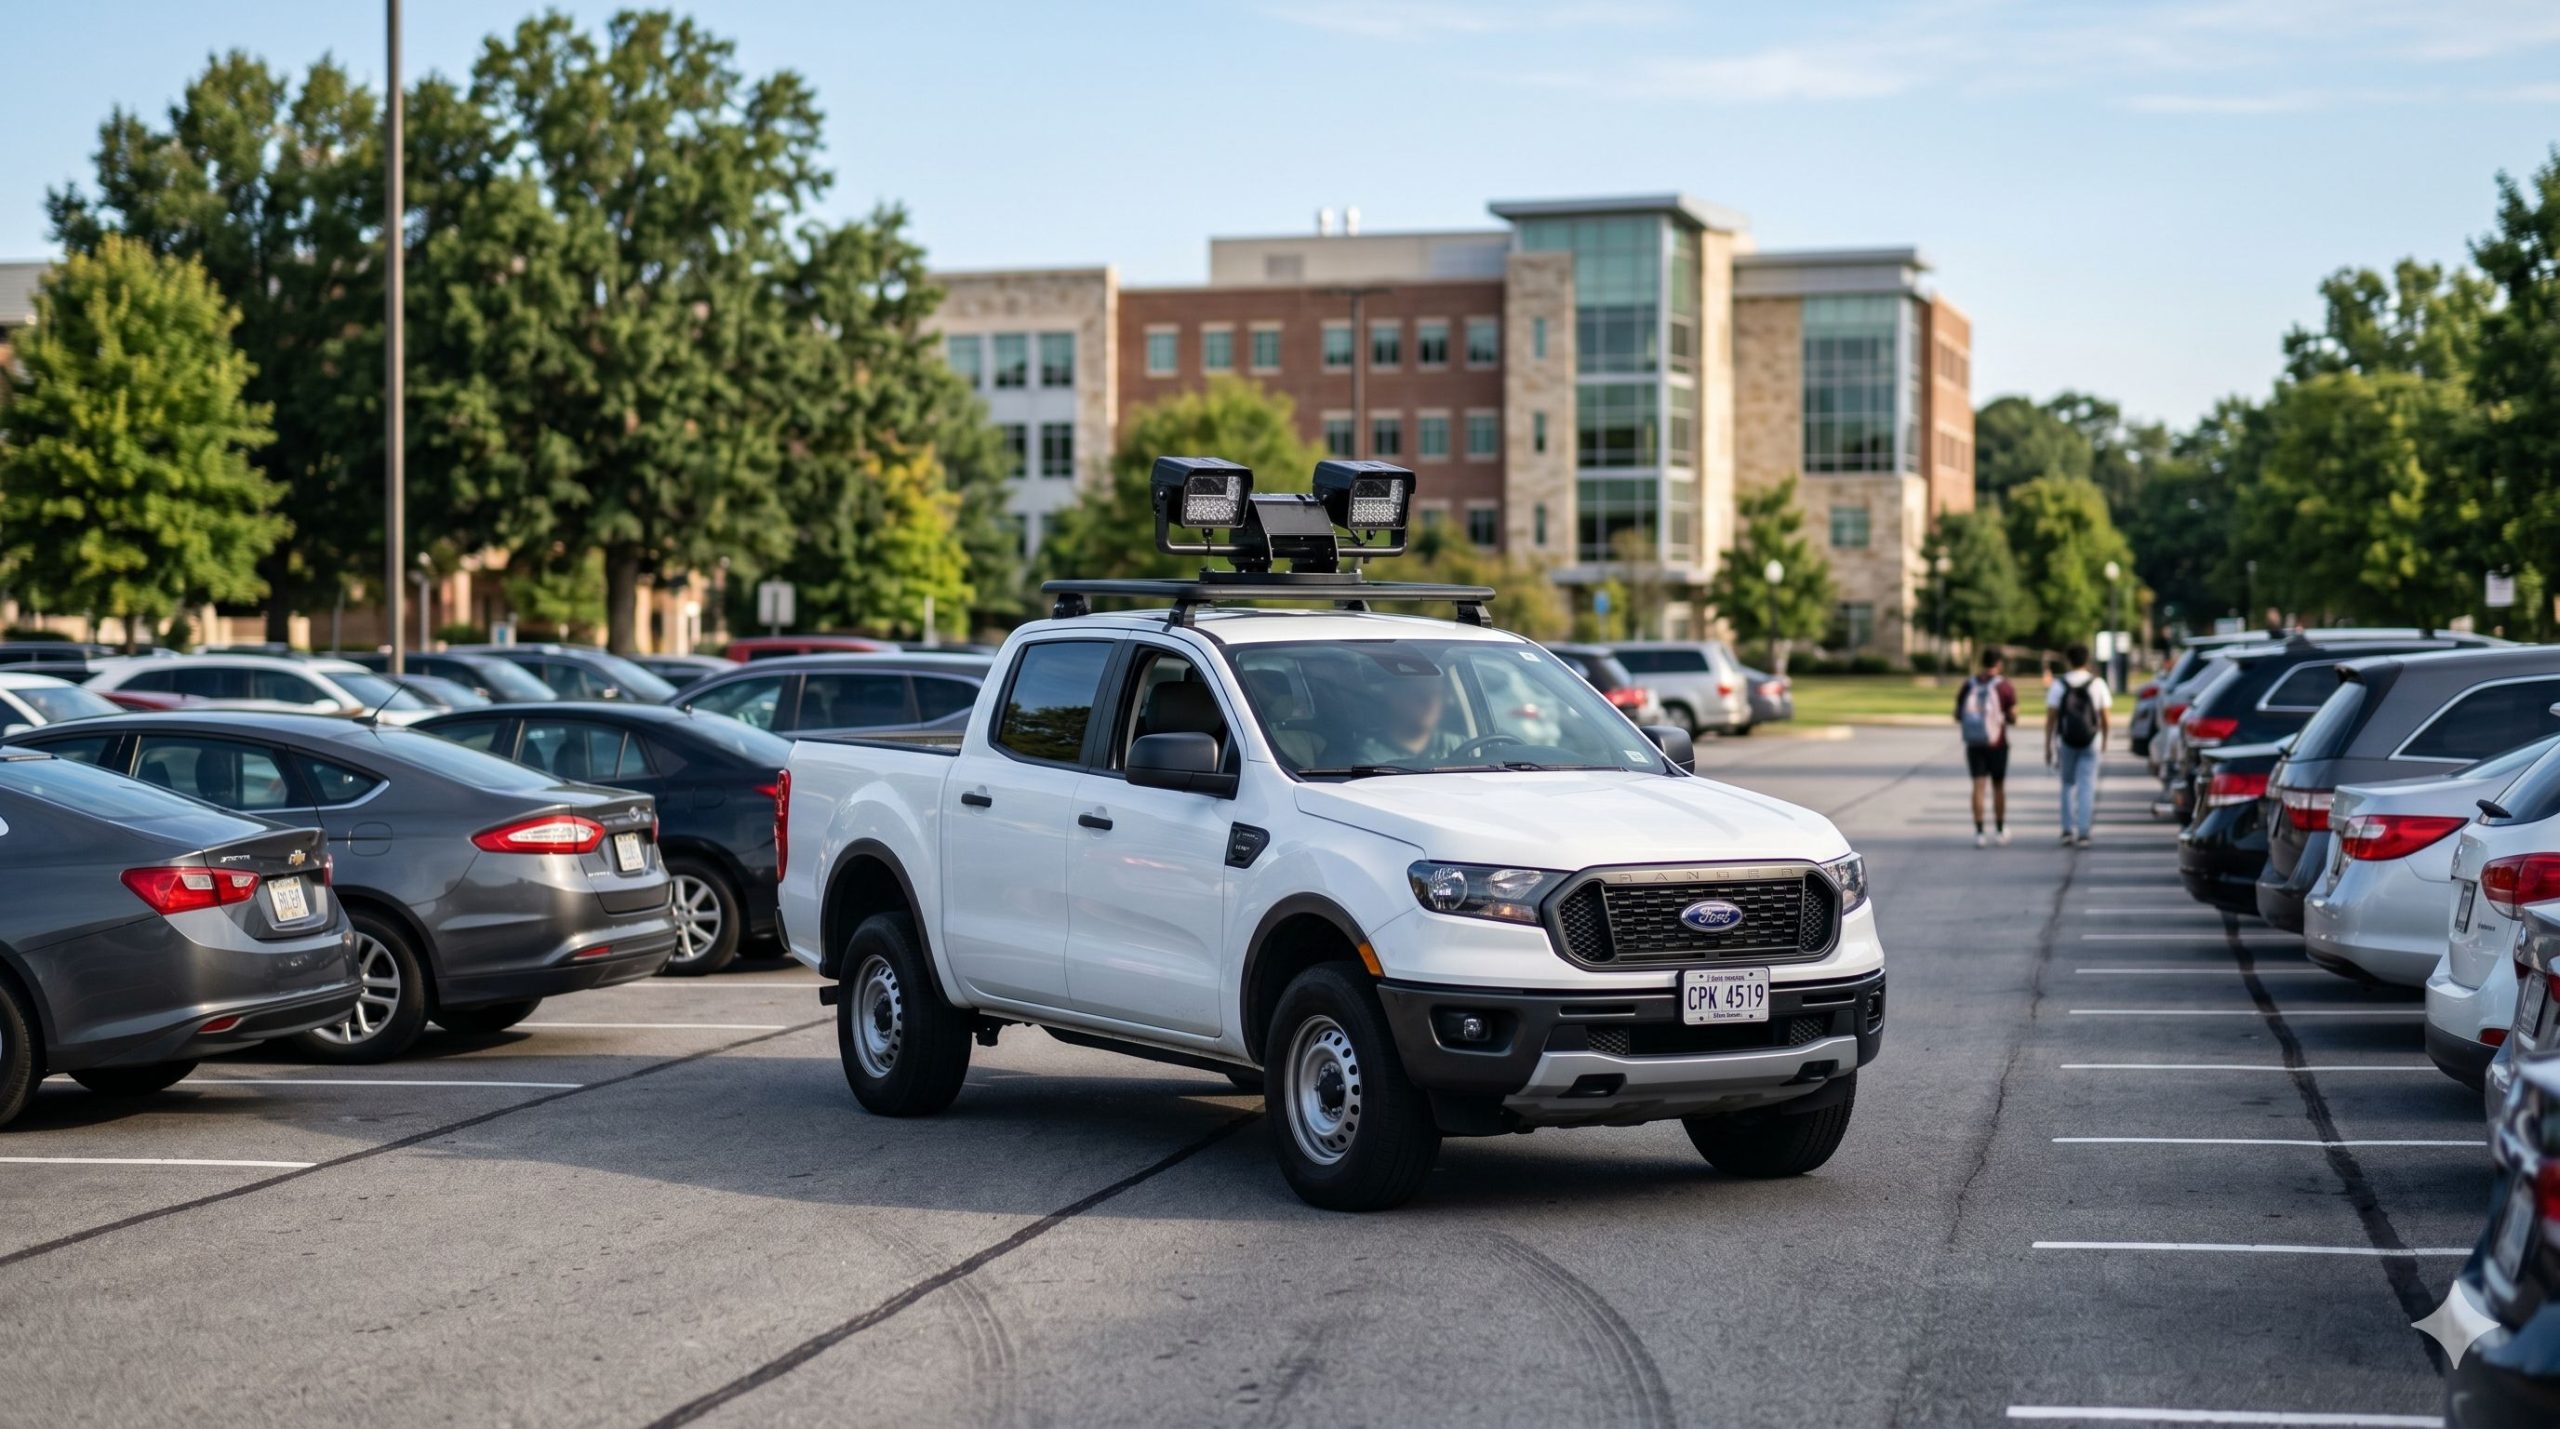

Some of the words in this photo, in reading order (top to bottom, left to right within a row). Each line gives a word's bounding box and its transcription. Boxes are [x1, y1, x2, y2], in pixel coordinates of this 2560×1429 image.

[1698, 906, 1732, 923] Ford
[1688, 985, 1717, 1010] CPK
[1726, 984, 1764, 1009] 4519
